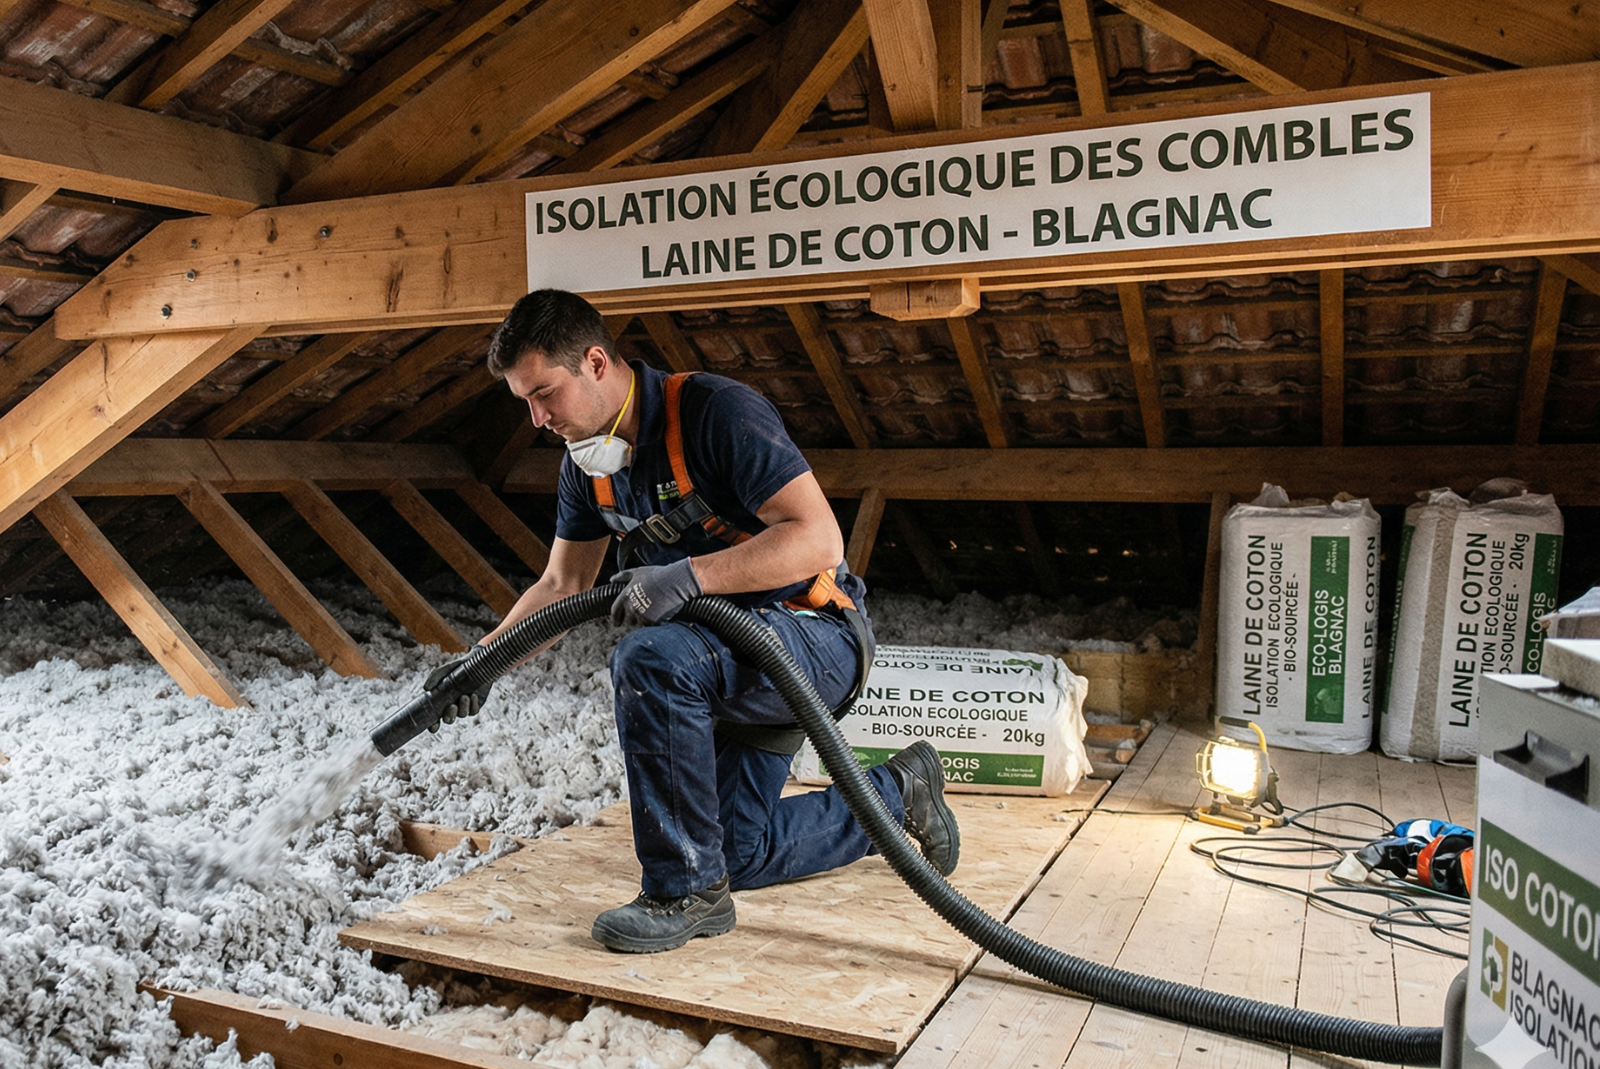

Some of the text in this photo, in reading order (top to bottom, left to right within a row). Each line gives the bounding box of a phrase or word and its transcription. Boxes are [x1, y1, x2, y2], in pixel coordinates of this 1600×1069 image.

[536, 108, 1415, 235] ISOLATION ÉCOLOGIQUE DES COMBLES
[642, 236, 756, 279] LAINE
[768, 230, 823, 269] DE
[834, 214, 989, 263] COTON
[1032, 188, 1273, 248] BLAGNAC
[1460, 533, 1487, 615] COTON
[1484, 541, 1506, 636] ECOLOGIQUE
[1508, 533, 1531, 571] 20kg
[873, 660, 929, 670] COTO
[1243, 535, 1266, 715] LAINE DE COTON
[1266, 542, 1283, 708] ISOLATION ECOLOGIQUE
[1282, 581, 1299, 672] BIO-SOURCÉE
[1313, 589, 1329, 677] ECO-LOGIS
[1328, 595, 1345, 674] BLAGNAC
[1362, 536, 1376, 719] LAINE DE COTON
[1457, 623, 1479, 653] DE
[1499, 593, 1520, 674] O-SOURCÉE
[1527, 592, 1546, 673] CO-LOGIS
[860, 687, 1046, 705] INE DE COTON
[935, 663, 963, 673] DE
[1449, 660, 1475, 728] LAINE
[848, 704, 1029, 722] SOLATION ECOLOGIQUE
[872, 723, 977, 740] BIO-SOURCÉE
[1003, 728, 1045, 747] 20kg
[1485, 844, 1519, 900] ISO
[1510, 989, 1600, 1069] ISOLATIO
[1511, 950, 1600, 1052] BLAGNAC
